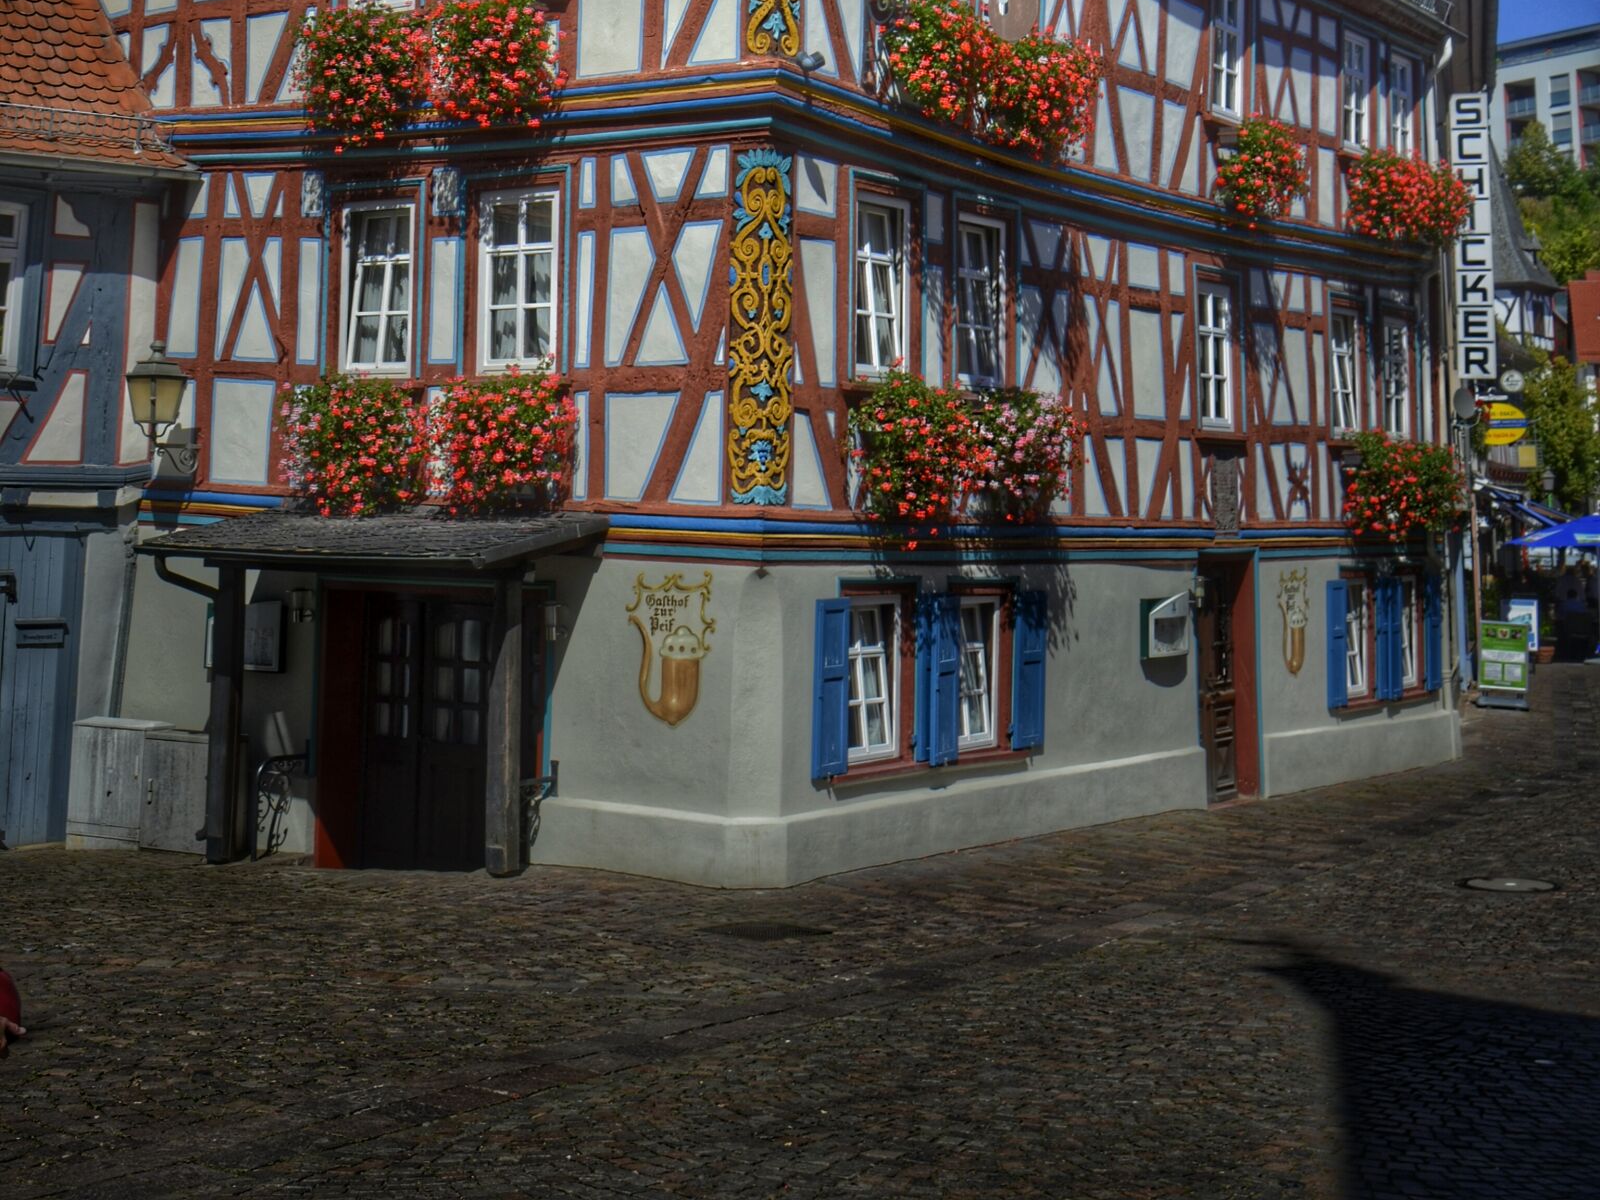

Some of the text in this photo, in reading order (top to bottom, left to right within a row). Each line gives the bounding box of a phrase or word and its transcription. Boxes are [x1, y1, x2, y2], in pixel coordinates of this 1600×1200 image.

[1456, 98, 1490, 374] SCHICKER
[654, 607, 674, 616] zur
[650, 616, 675, 636] Peif
